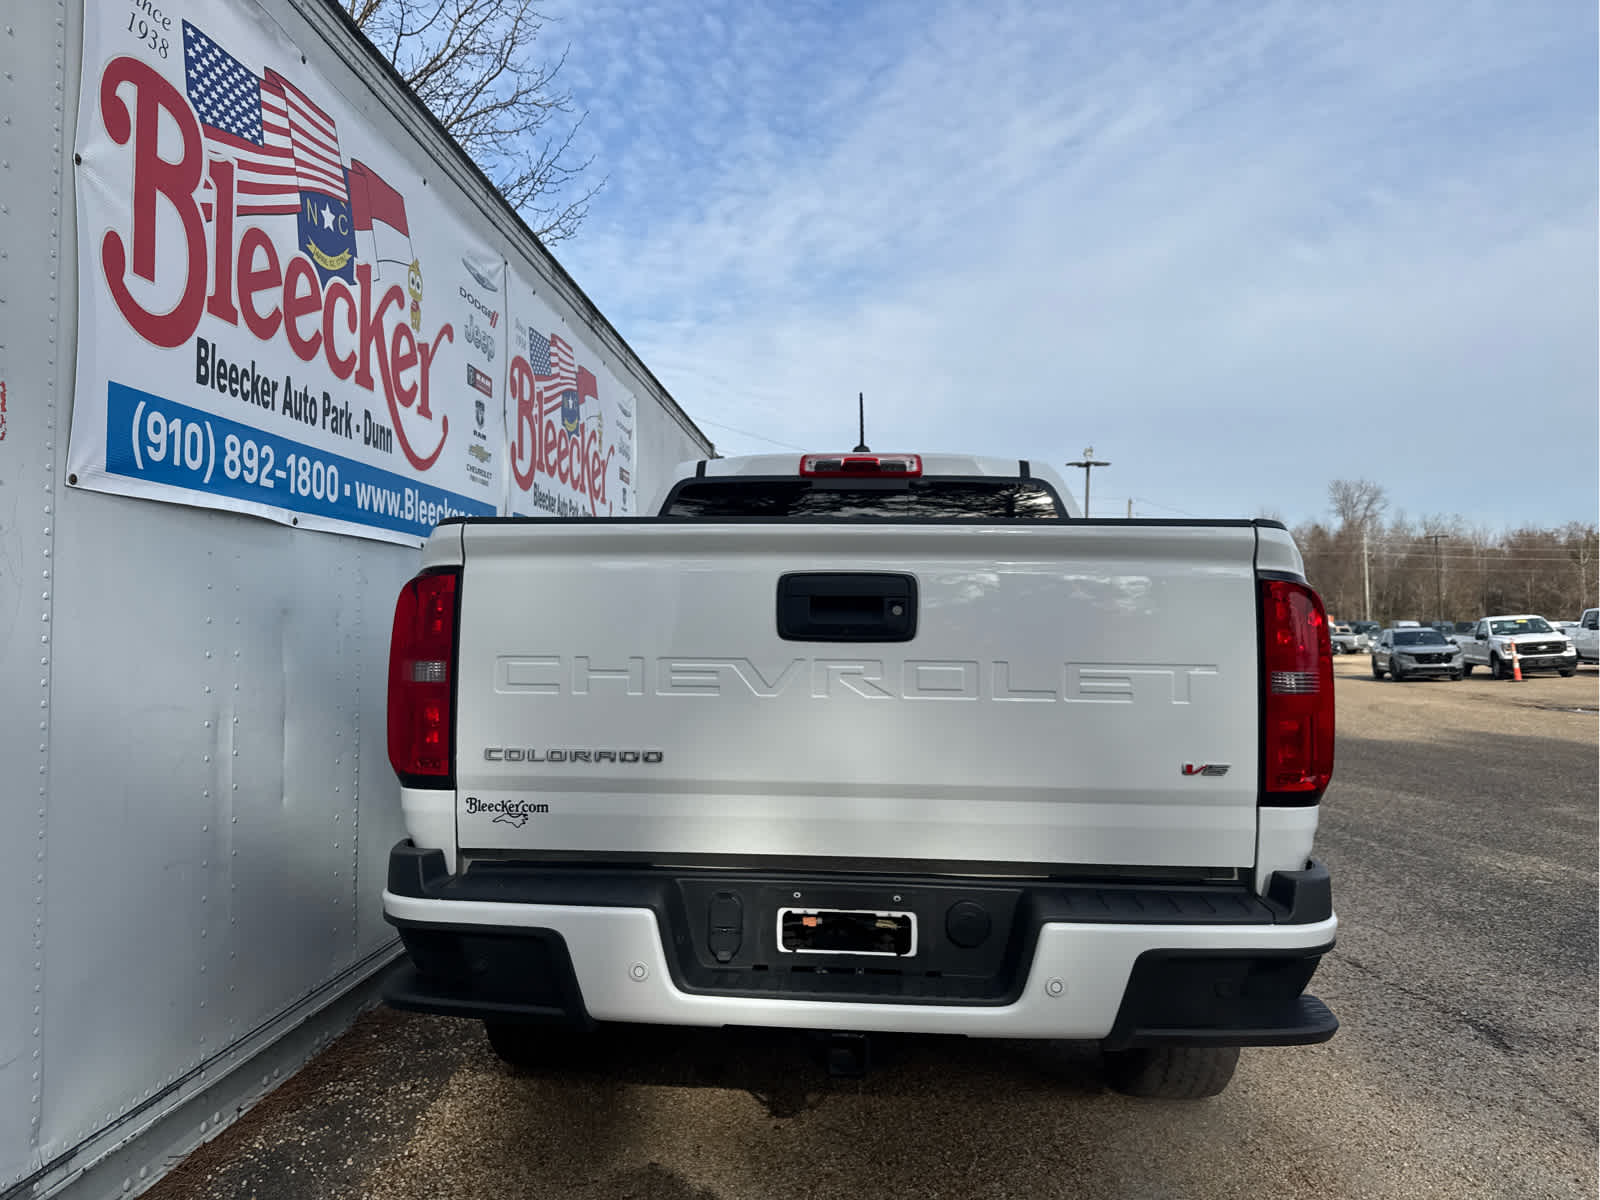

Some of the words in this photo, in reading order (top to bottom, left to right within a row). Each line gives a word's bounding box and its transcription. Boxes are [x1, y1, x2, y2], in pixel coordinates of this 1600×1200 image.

[128, 12, 169, 59] 1938
[101, 57, 453, 470] Bleecker
[459, 286, 493, 321] DODGE
[464, 314, 495, 362] Jeep
[196, 336, 278, 412] Bleecker
[282, 376, 318, 427] Auto
[322, 392, 353, 440] Park
[364, 409, 393, 454] Dunn
[132, 401, 215, 484] (910)
[224, 434, 339, 503] 892-1800
[473, 430, 487, 441] RAM
[494, 654, 1219, 705] CHEVROLET
[484, 747, 665, 764] COLORADO
